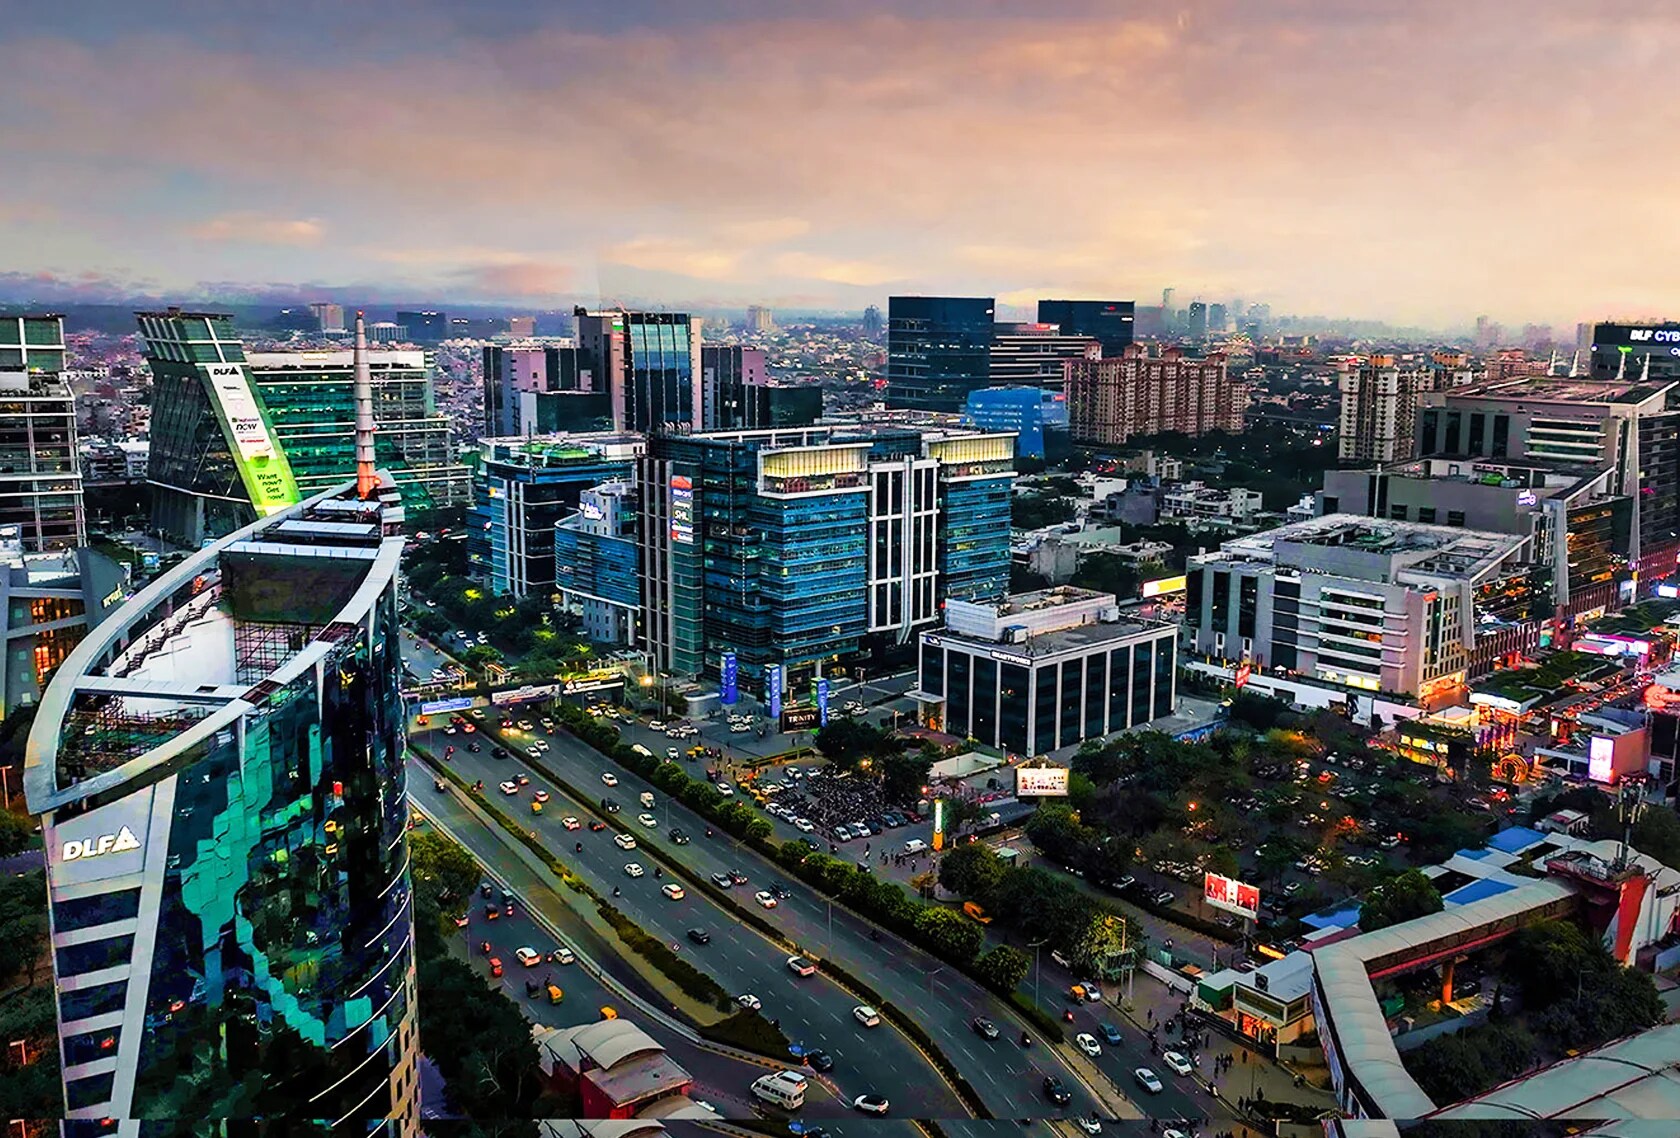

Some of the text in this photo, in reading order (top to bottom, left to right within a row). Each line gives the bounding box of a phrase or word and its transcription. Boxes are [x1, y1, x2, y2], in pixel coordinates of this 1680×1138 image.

[1630, 329, 1653, 341] DLF
[236, 423, 257, 432] now
[257, 473, 278, 481] Want
[265, 486, 280, 495] Get
